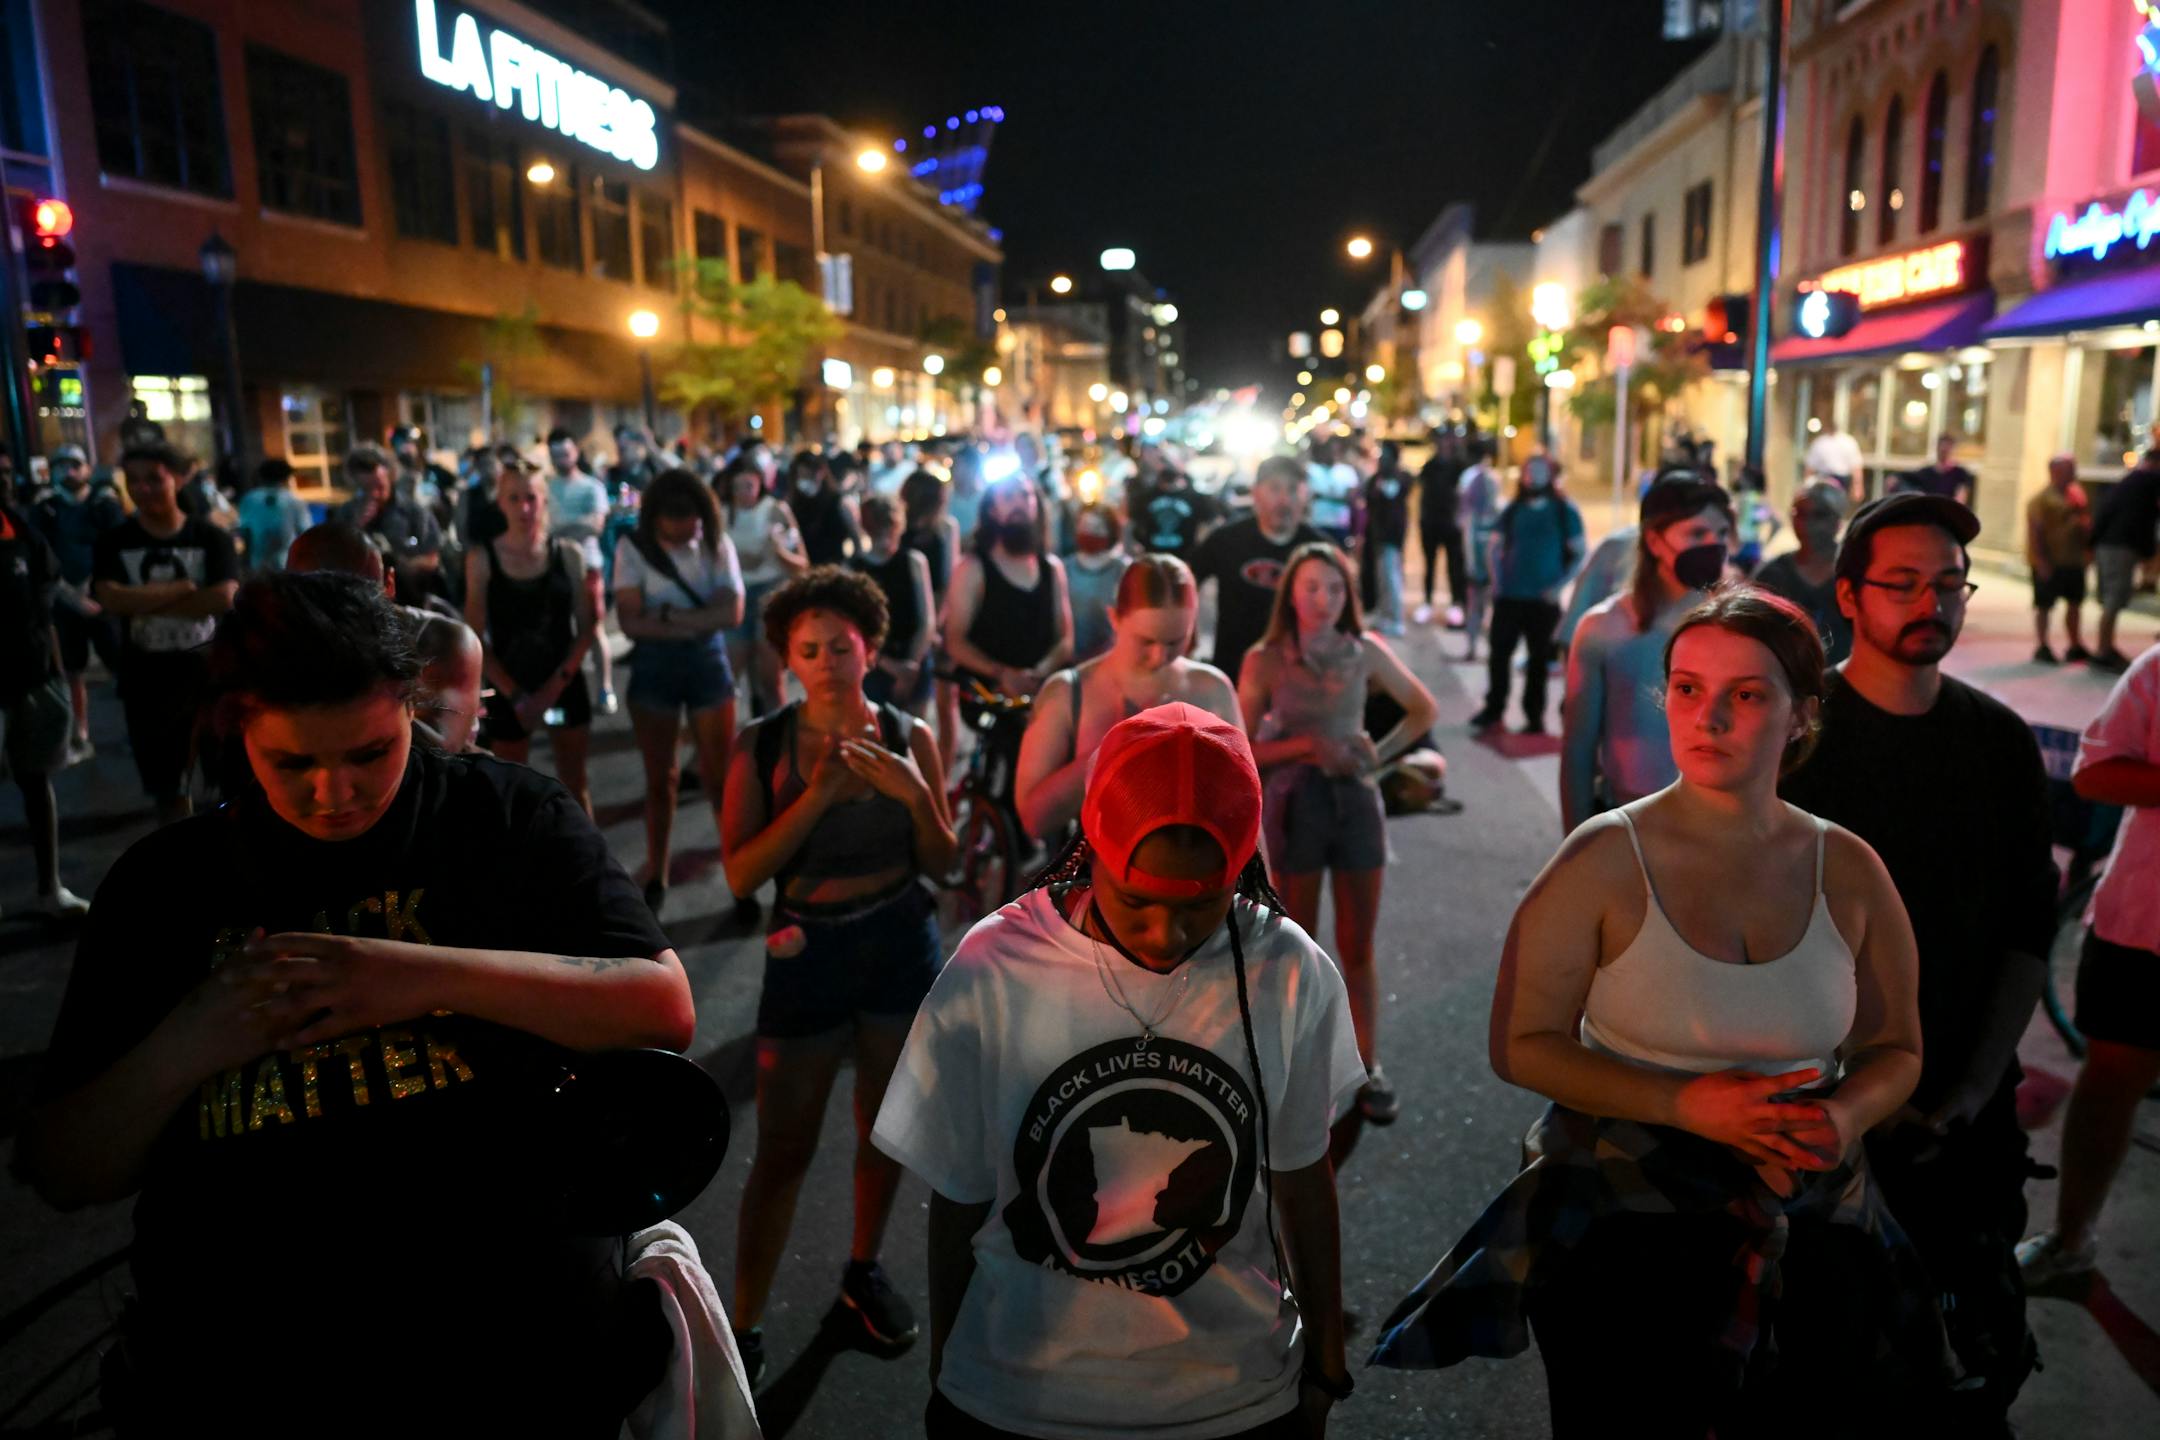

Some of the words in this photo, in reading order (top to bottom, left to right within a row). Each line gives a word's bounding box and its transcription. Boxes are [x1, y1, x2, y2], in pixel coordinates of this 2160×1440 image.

[416, 0, 493, 101] LA
[490, 29, 658, 170] FITNESS
[1029, 1069, 1092, 1142] BLACK
[1095, 1052, 1161, 1079] LIVES
[1168, 1054, 1249, 1125] MATTER
